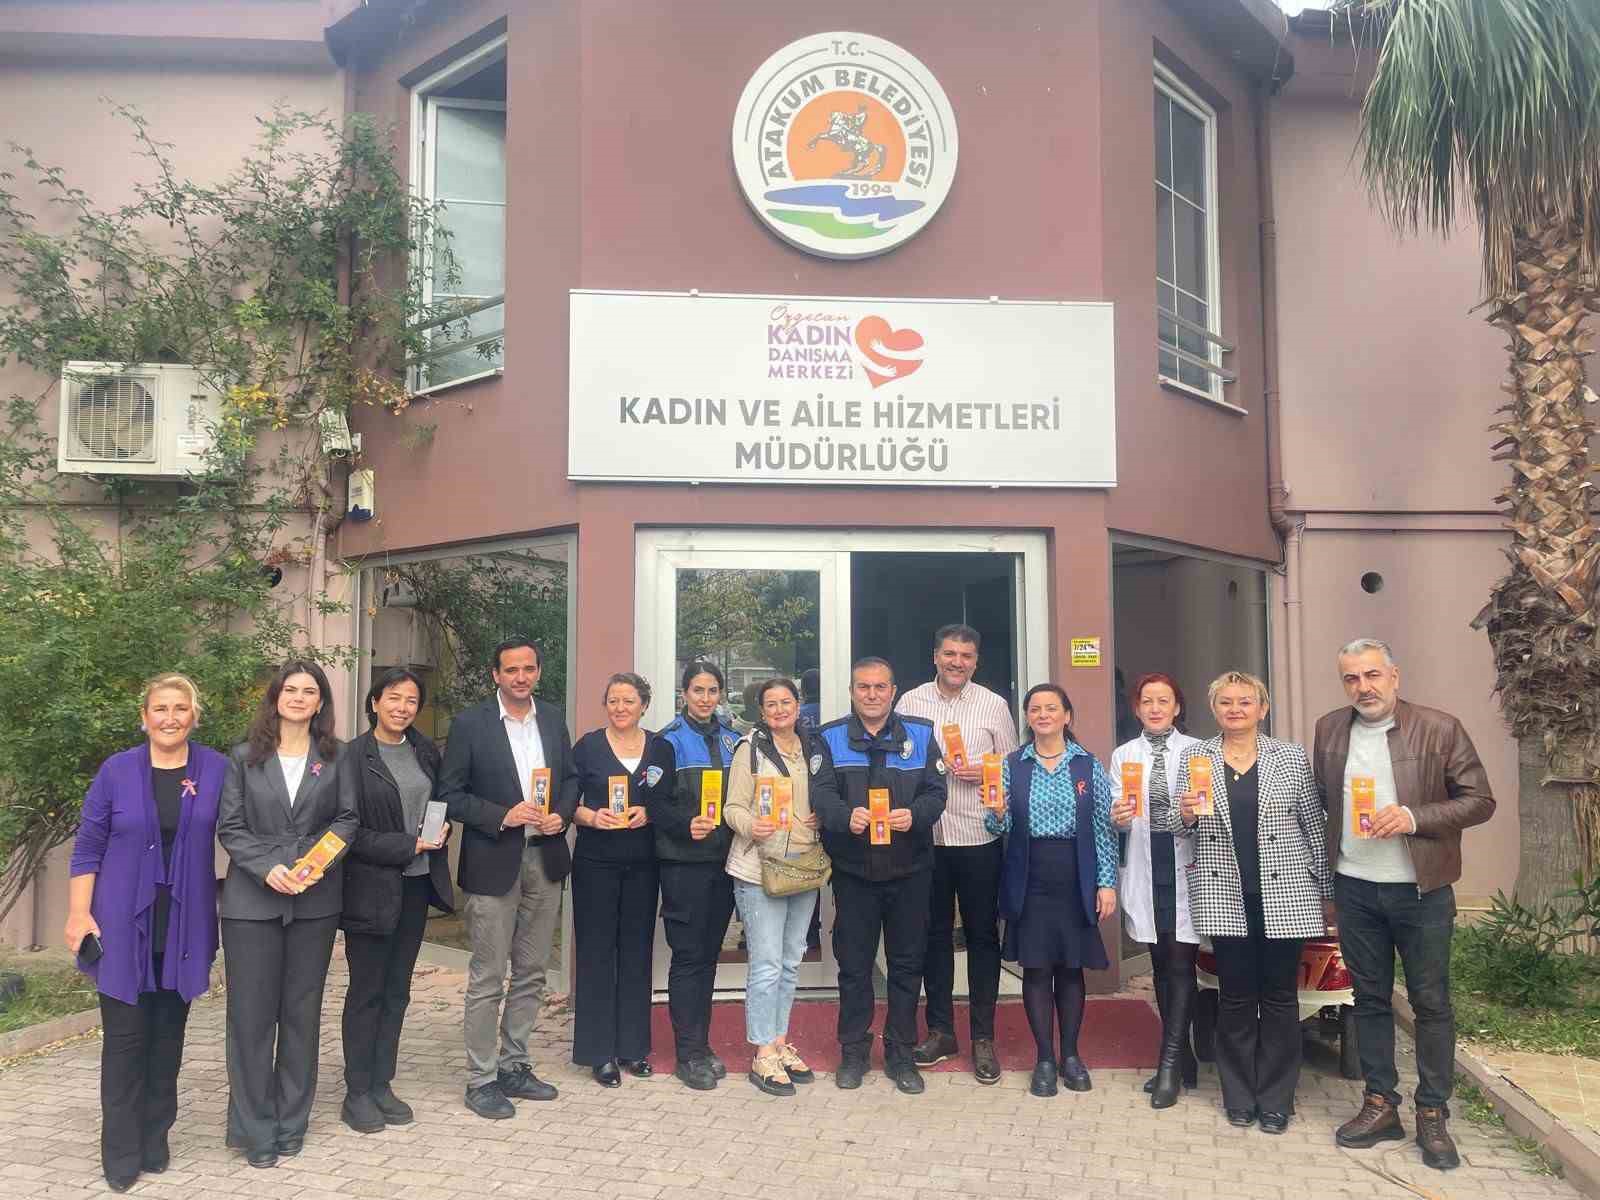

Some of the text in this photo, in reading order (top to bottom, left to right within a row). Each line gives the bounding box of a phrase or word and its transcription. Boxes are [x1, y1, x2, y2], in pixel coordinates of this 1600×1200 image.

[831, 40, 865, 56] T.C.
[764, 69, 928, 190] ATAKUM BELEDİYESİ
[852, 183, 893, 196] 1994
[767, 324, 852, 345] KADIN
[768, 347, 852, 363] DANIŞMA
[620, 392, 1063, 430] KADIN VE AİLE HİZMETLERİ
[735, 436, 949, 472] MÜDÜRLÜĞÜ
